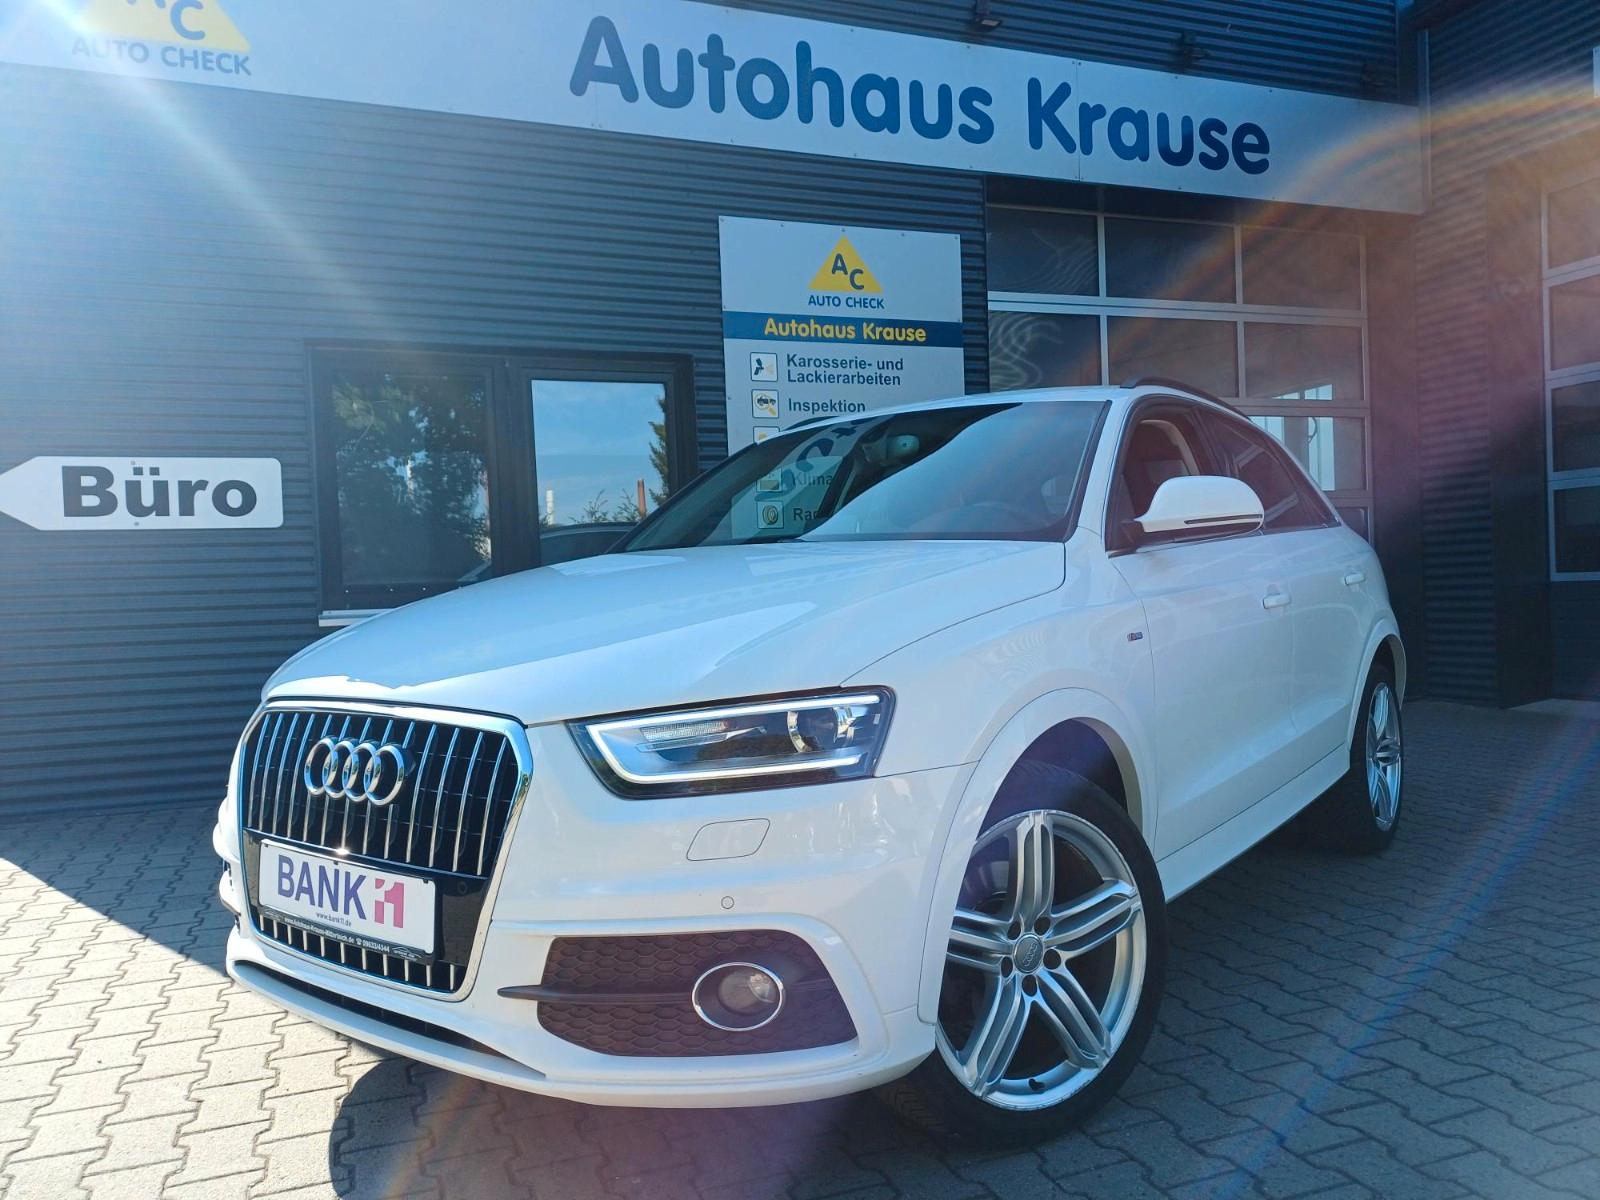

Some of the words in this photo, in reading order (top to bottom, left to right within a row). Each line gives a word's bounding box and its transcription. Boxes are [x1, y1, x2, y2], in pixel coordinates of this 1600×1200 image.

[71, 37, 149, 64] AUTO
[160, 46, 252, 76] CHECK
[569, 16, 995, 144] Autohaus
[1026, 77, 1271, 175] Krause
[808, 294, 841, 308] AUTO
[845, 296, 885, 309] CHECK
[764, 317, 856, 339] Autohaus
[863, 322, 926, 342] Krause
[787, 353, 872, 370] Karosserie-
[876, 358, 904, 371] und
[787, 369, 901, 386] Lackierarbeiten
[788, 398, 866, 414] Inspektion
[61, 465, 257, 518] Büro
